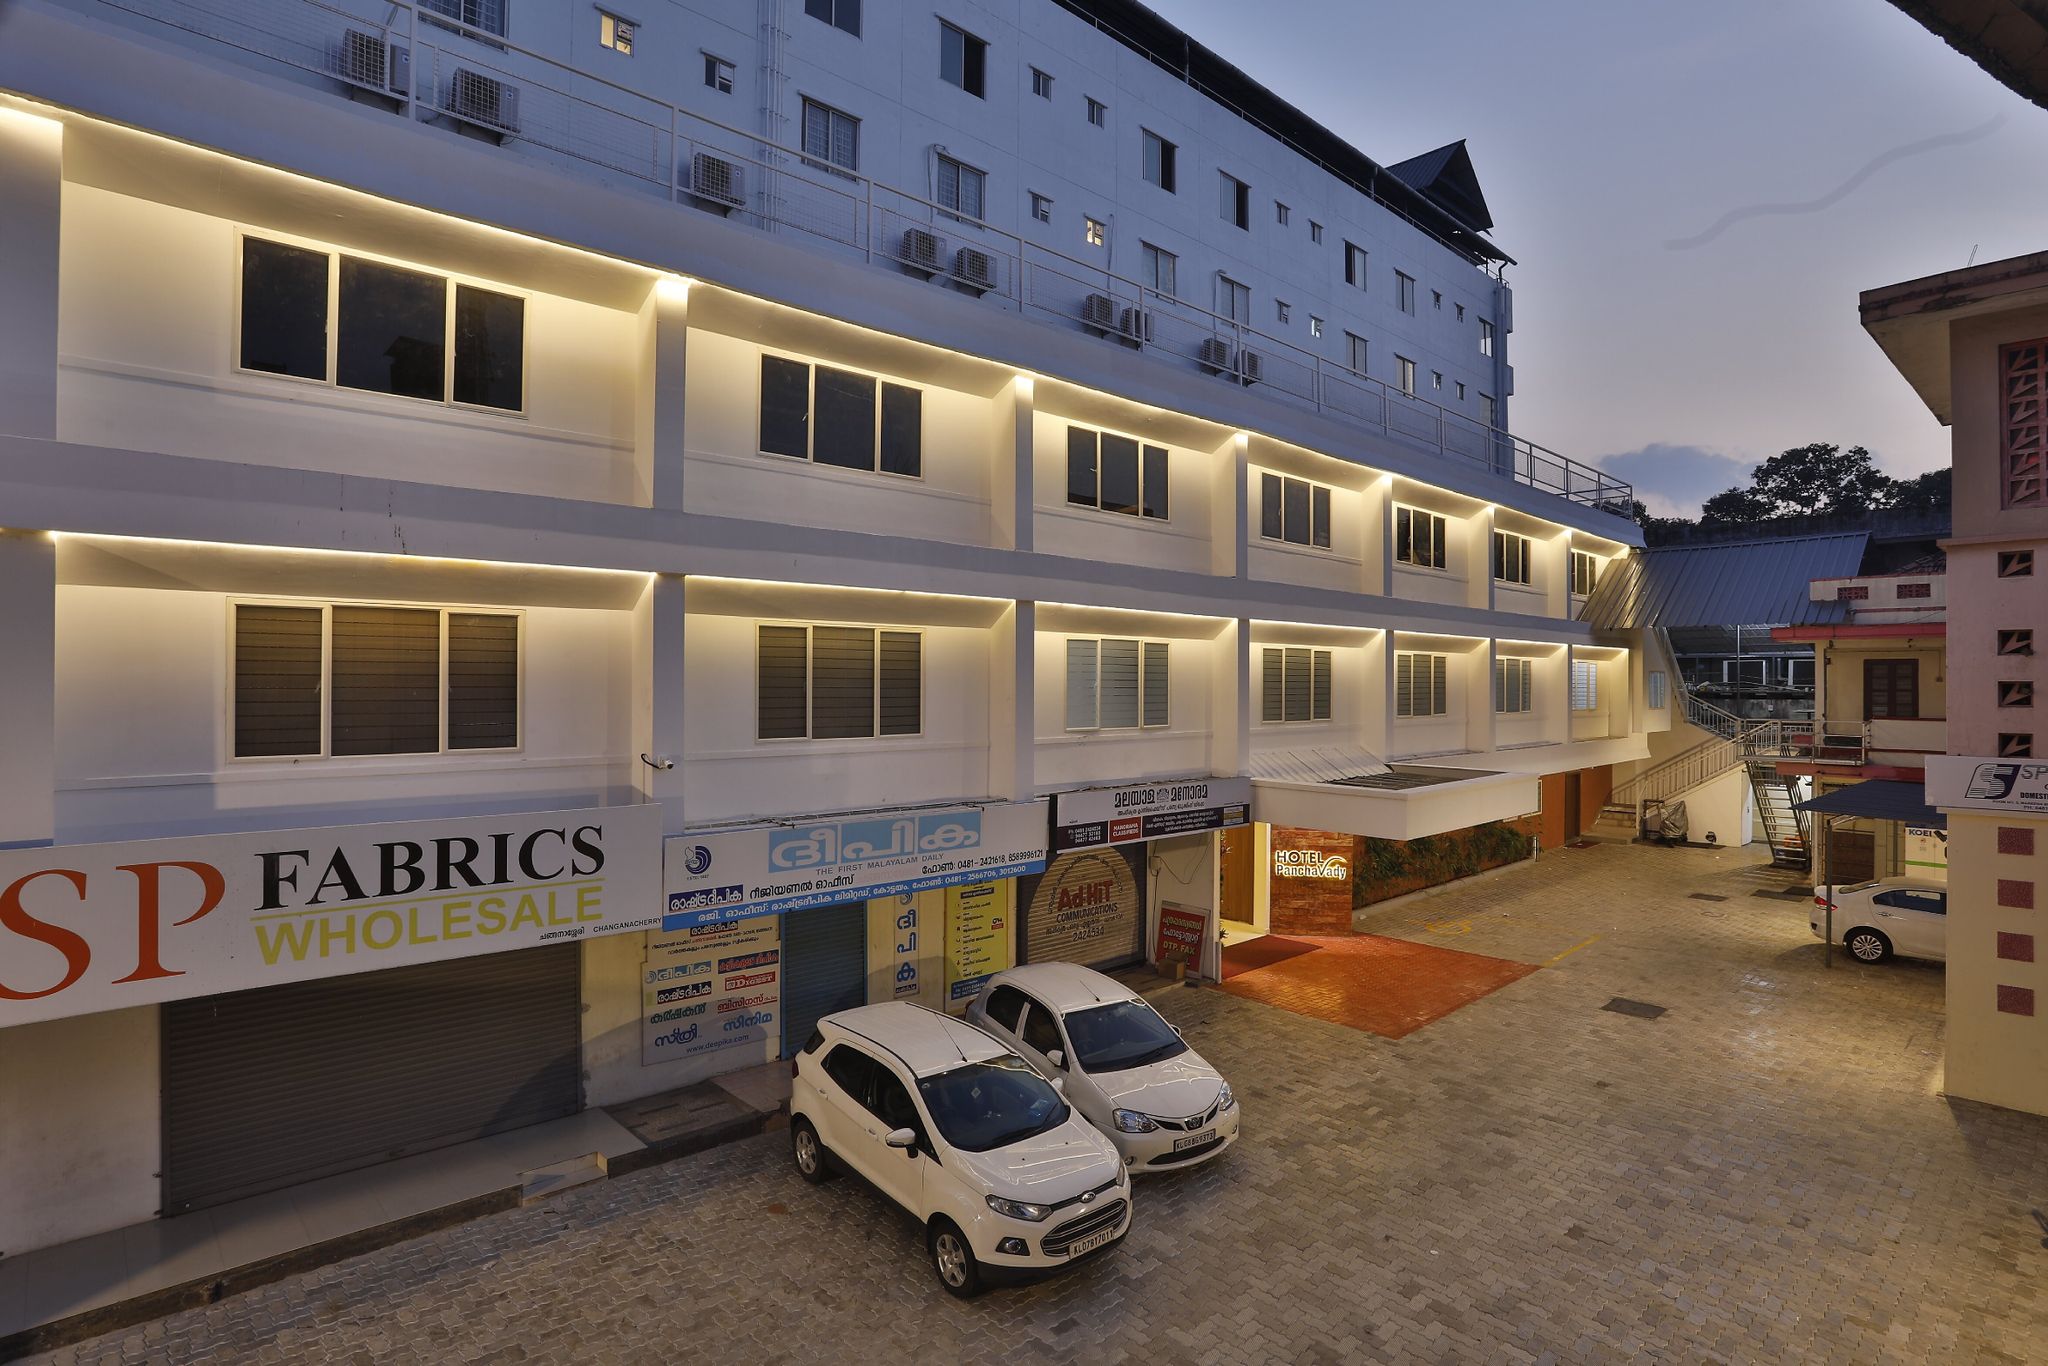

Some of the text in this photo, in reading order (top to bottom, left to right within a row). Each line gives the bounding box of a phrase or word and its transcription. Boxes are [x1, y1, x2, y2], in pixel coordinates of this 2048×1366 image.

[771, 819, 979, 868] ദീപിക
[1275, 850, 1324, 864] HOTEL
[254, 825, 606, 911] FABRICS
[816, 853, 944, 877] THE FIRST MALAYALAM DAILY
[0, 861, 226, 1000] SP
[257, 885, 604, 966] WHOLESALE
[593, 917, 662, 933] CHANGANACHERRY
[686, 1034, 749, 1053] www.deepika.com
